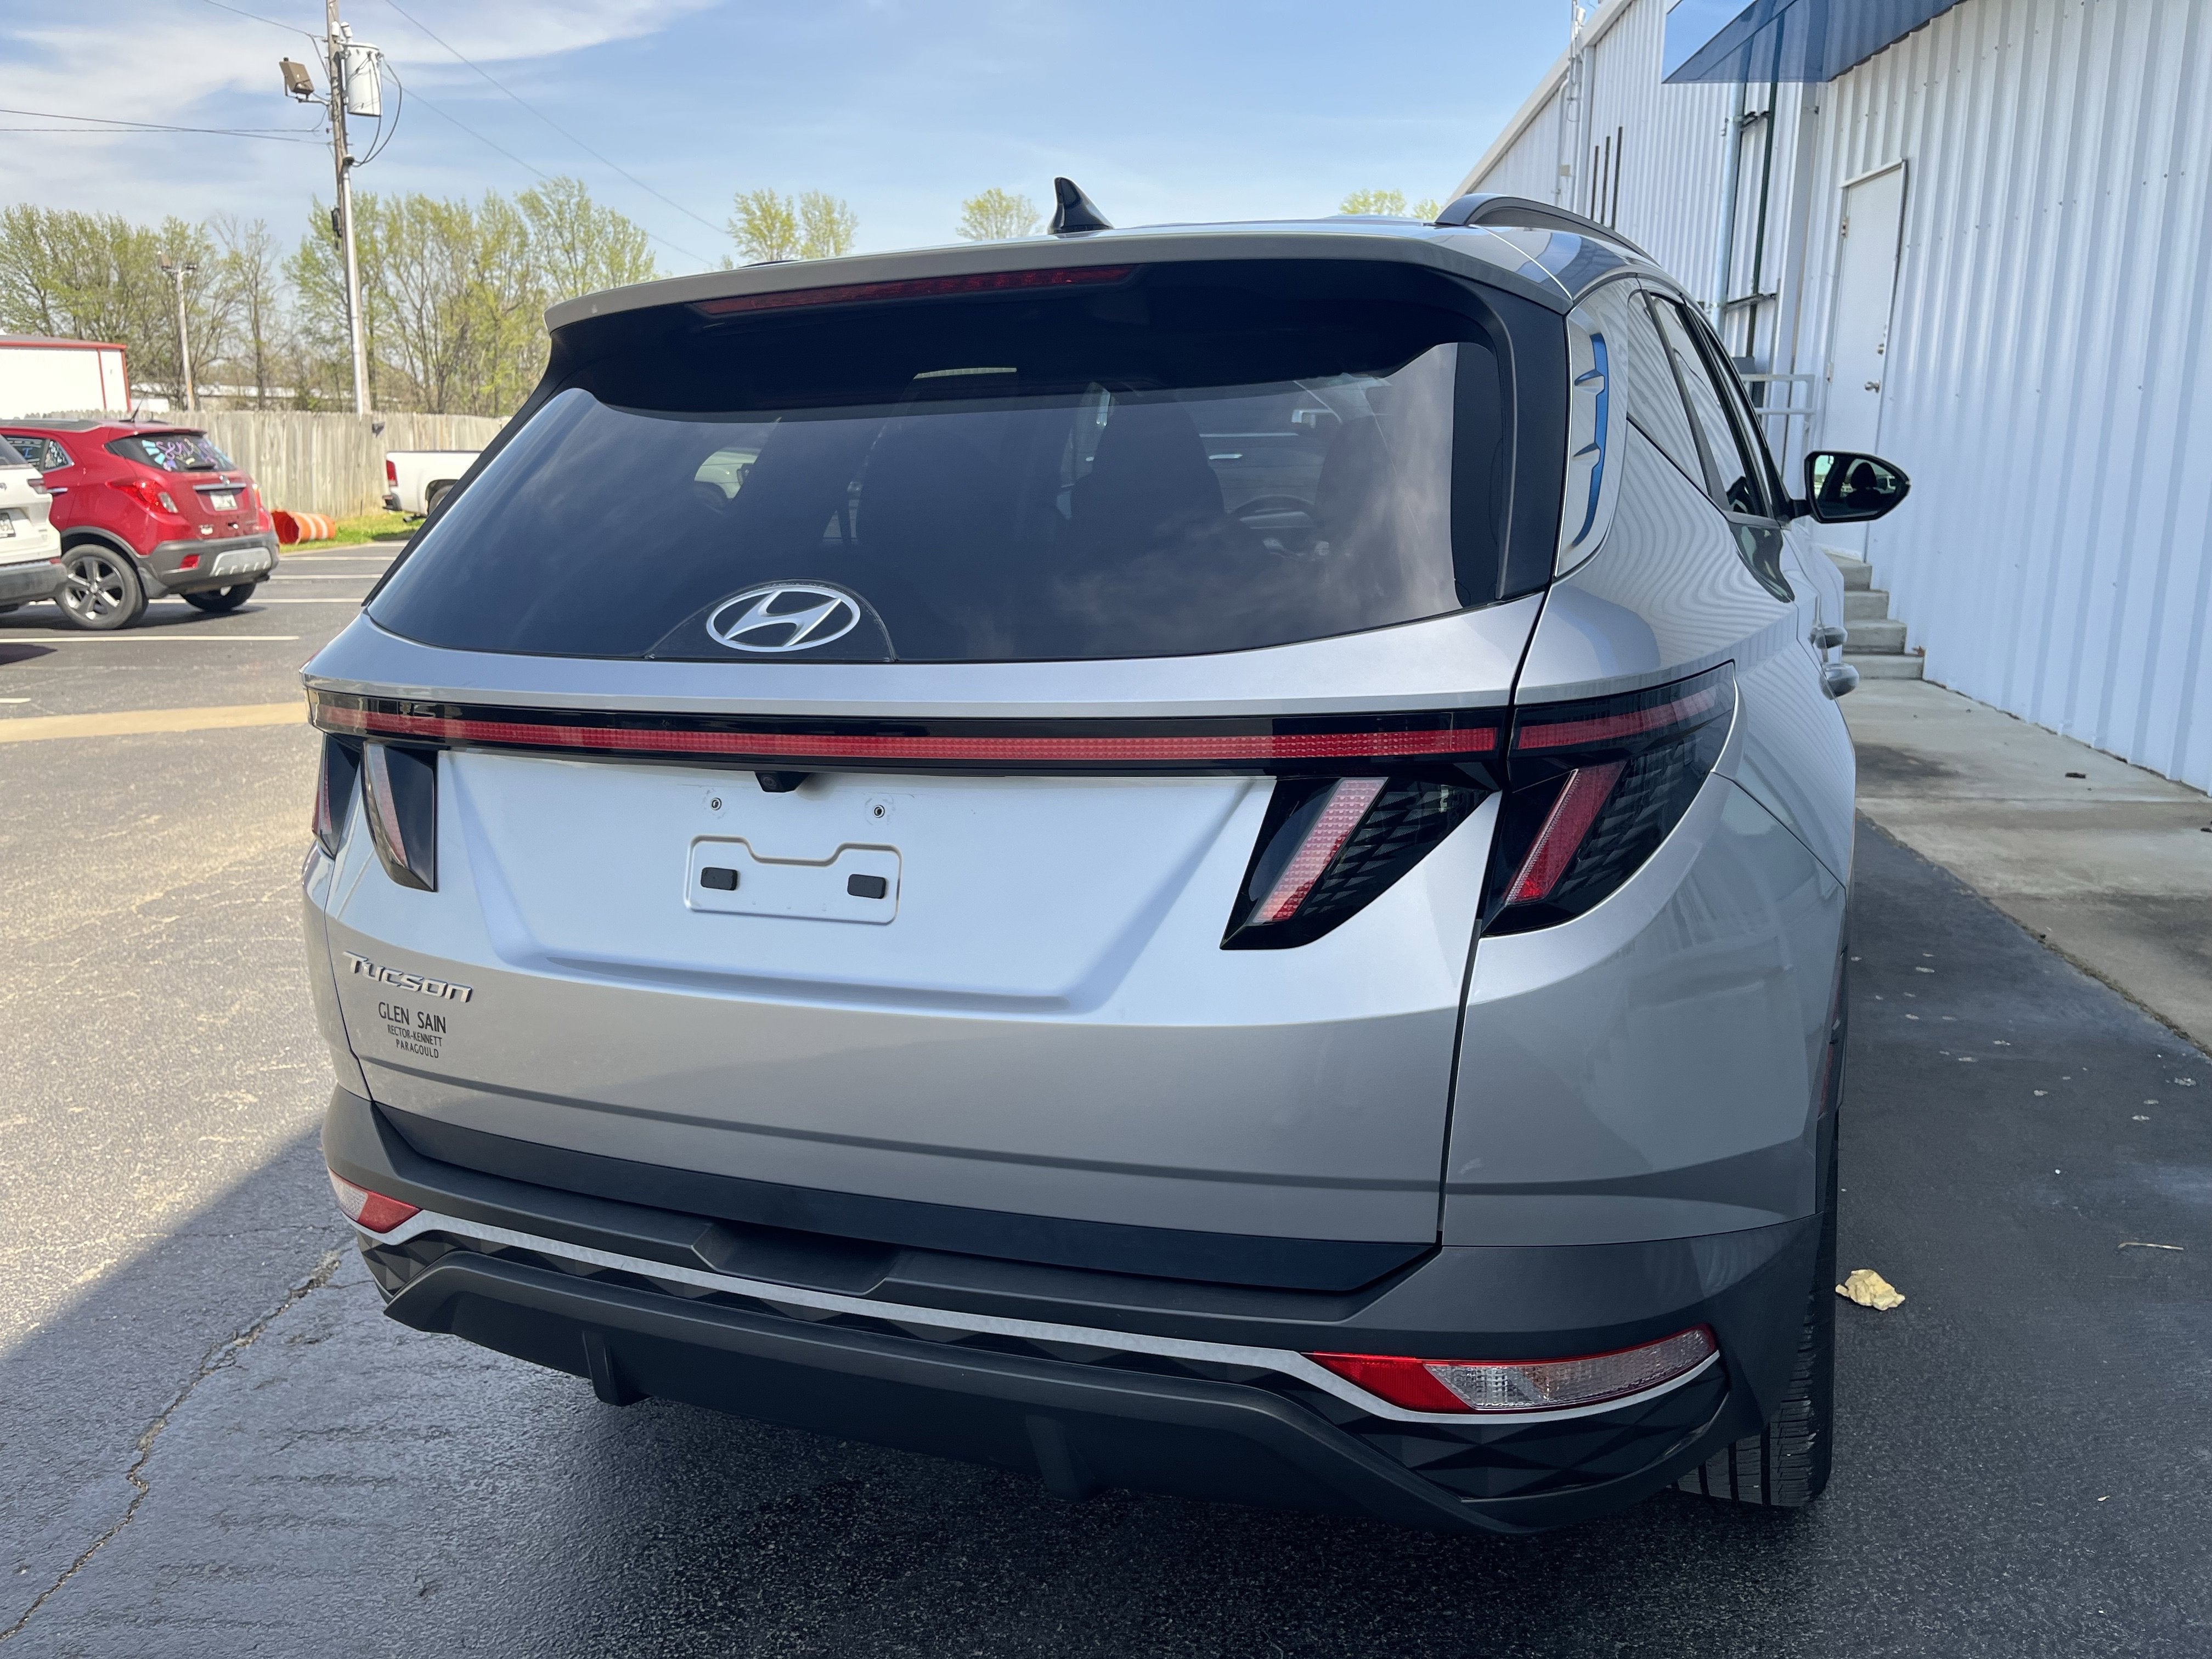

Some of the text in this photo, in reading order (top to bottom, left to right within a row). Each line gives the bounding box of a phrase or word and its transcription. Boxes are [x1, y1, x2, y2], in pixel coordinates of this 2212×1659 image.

[379, 1002, 447, 1034] GLEN SAIN
[387, 1024, 442, 1047] RECTOR-KENNETT
[396, 1039, 439, 1059] PARAGOULD
